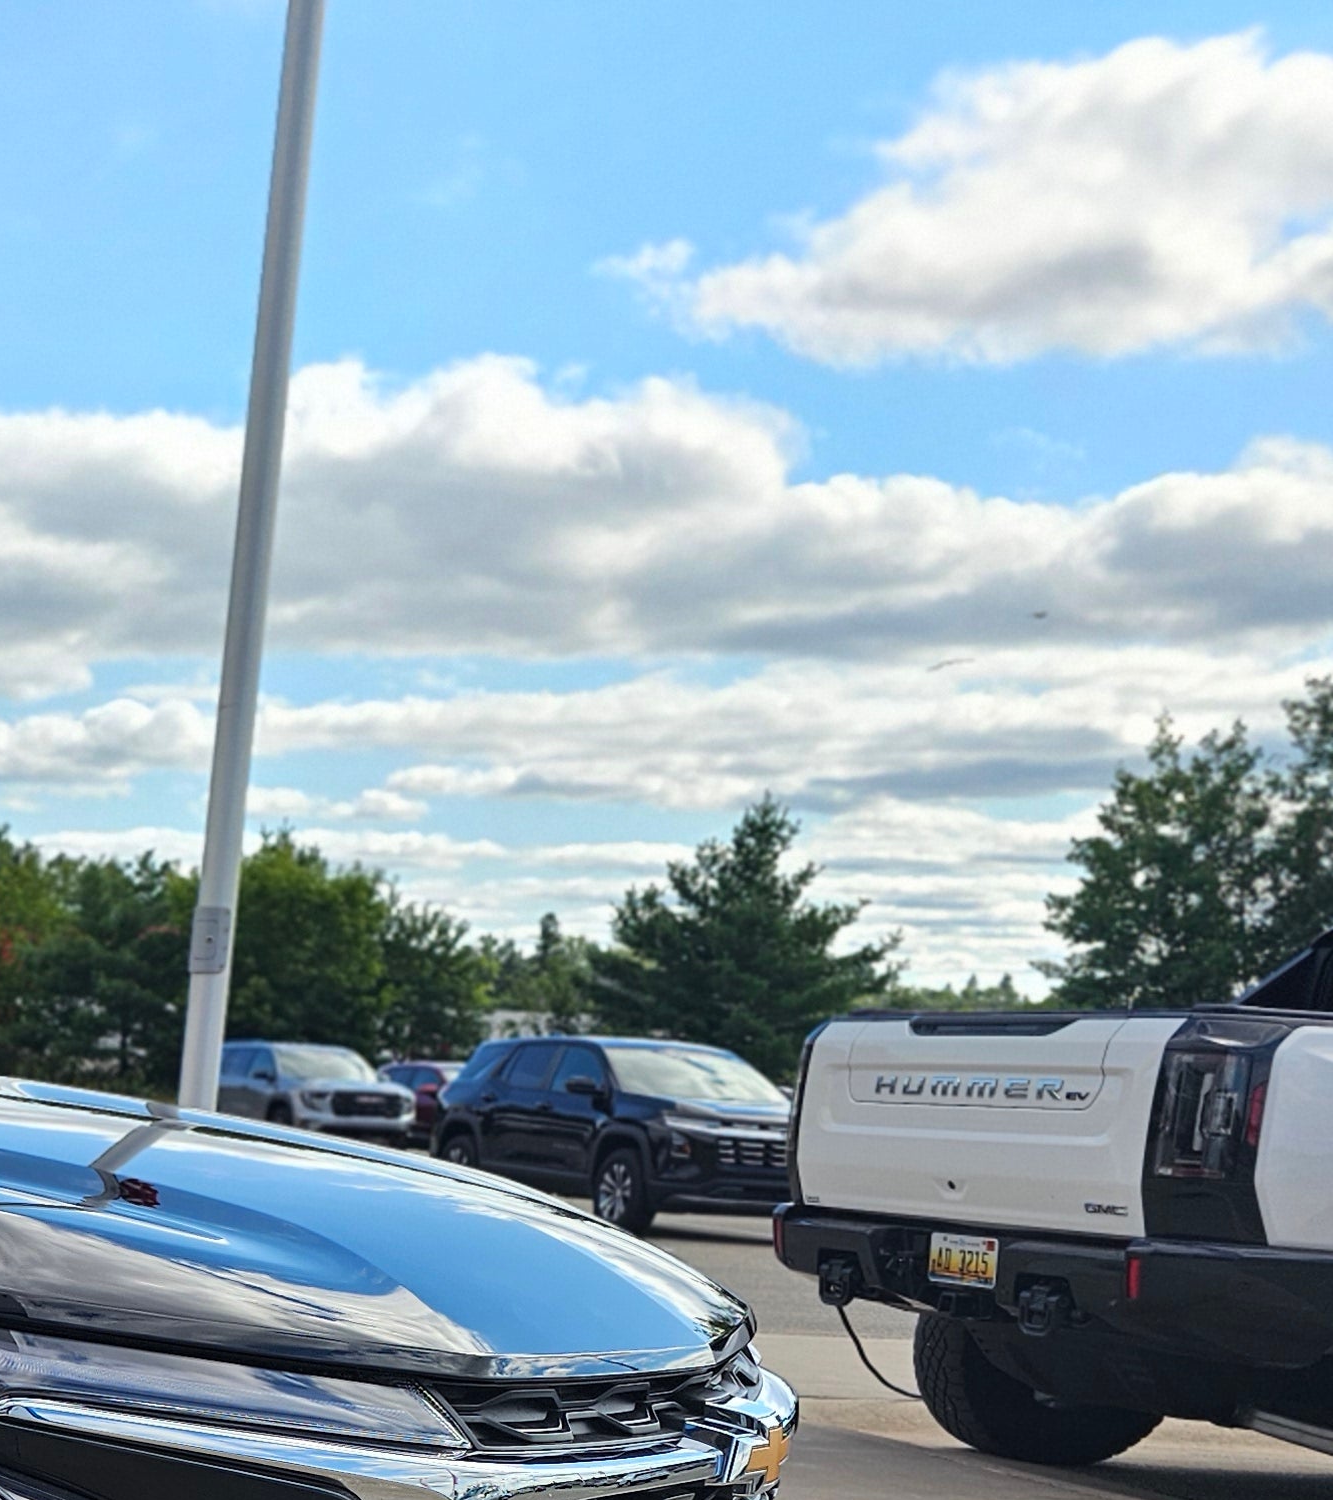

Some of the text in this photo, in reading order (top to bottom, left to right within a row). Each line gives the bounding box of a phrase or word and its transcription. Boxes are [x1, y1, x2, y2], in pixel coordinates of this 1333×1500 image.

[874, 1075, 1090, 1101] HUMMER EV
[1084, 1203, 1129, 1217] GMC
